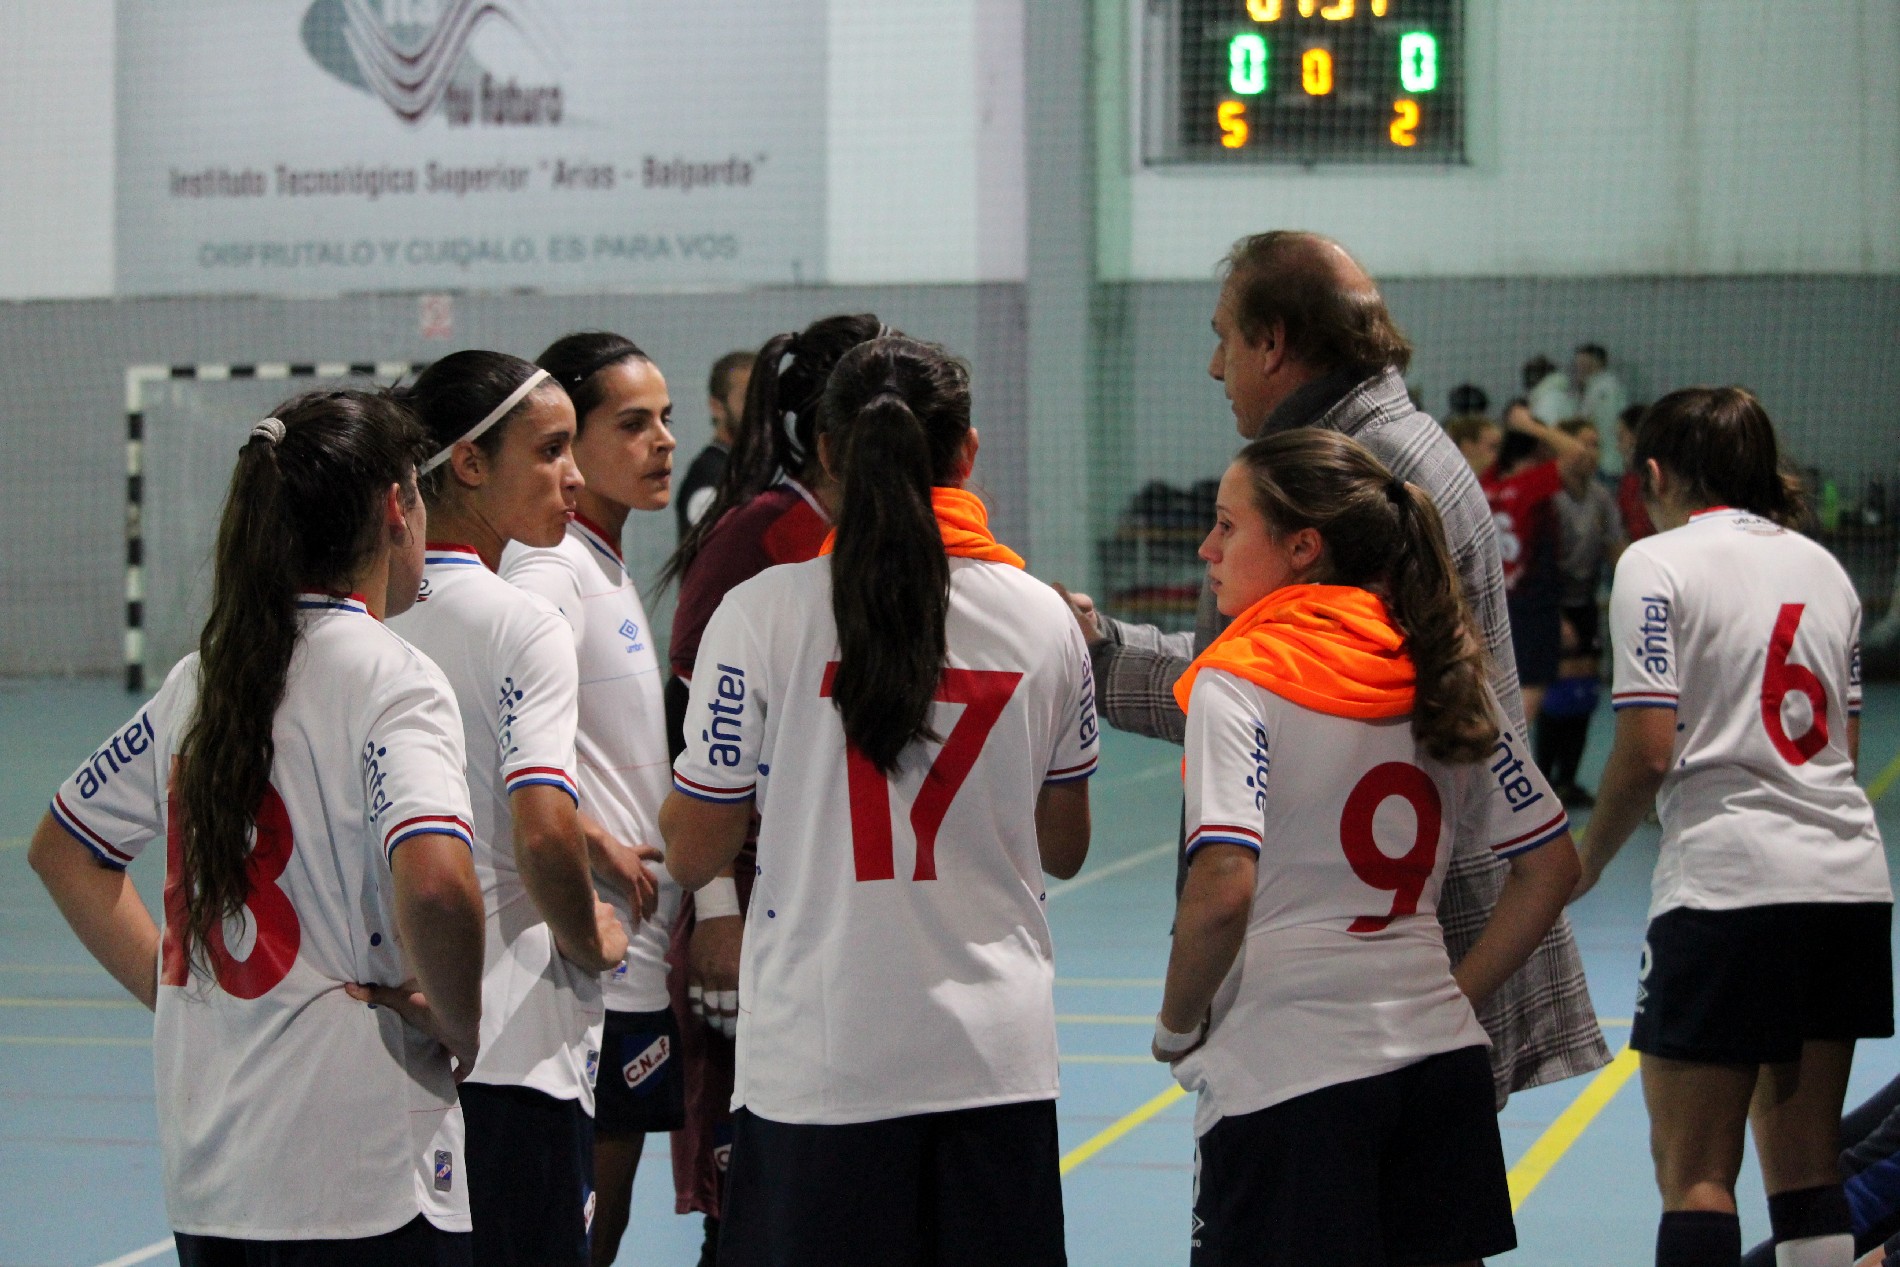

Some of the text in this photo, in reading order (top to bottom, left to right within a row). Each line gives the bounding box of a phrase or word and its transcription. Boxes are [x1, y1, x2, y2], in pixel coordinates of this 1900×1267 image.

[1230, 32, 1436, 95] 0 0 0
[1218, 99, 1419, 148] 5 2
[425, 158, 529, 198] Superior
[377, 239, 400, 265] Y
[548, 234, 586, 263] ES
[593, 233, 670, 261] PARA
[674, 232, 738, 260] VOS
[1636, 597, 1669, 674] antel
[703, 664, 745, 766] antel
[1760, 603, 1828, 766] 6
[76, 711, 154, 799] antel
[819, 661, 1023, 882] 17
[1340, 761, 1441, 933] 9
